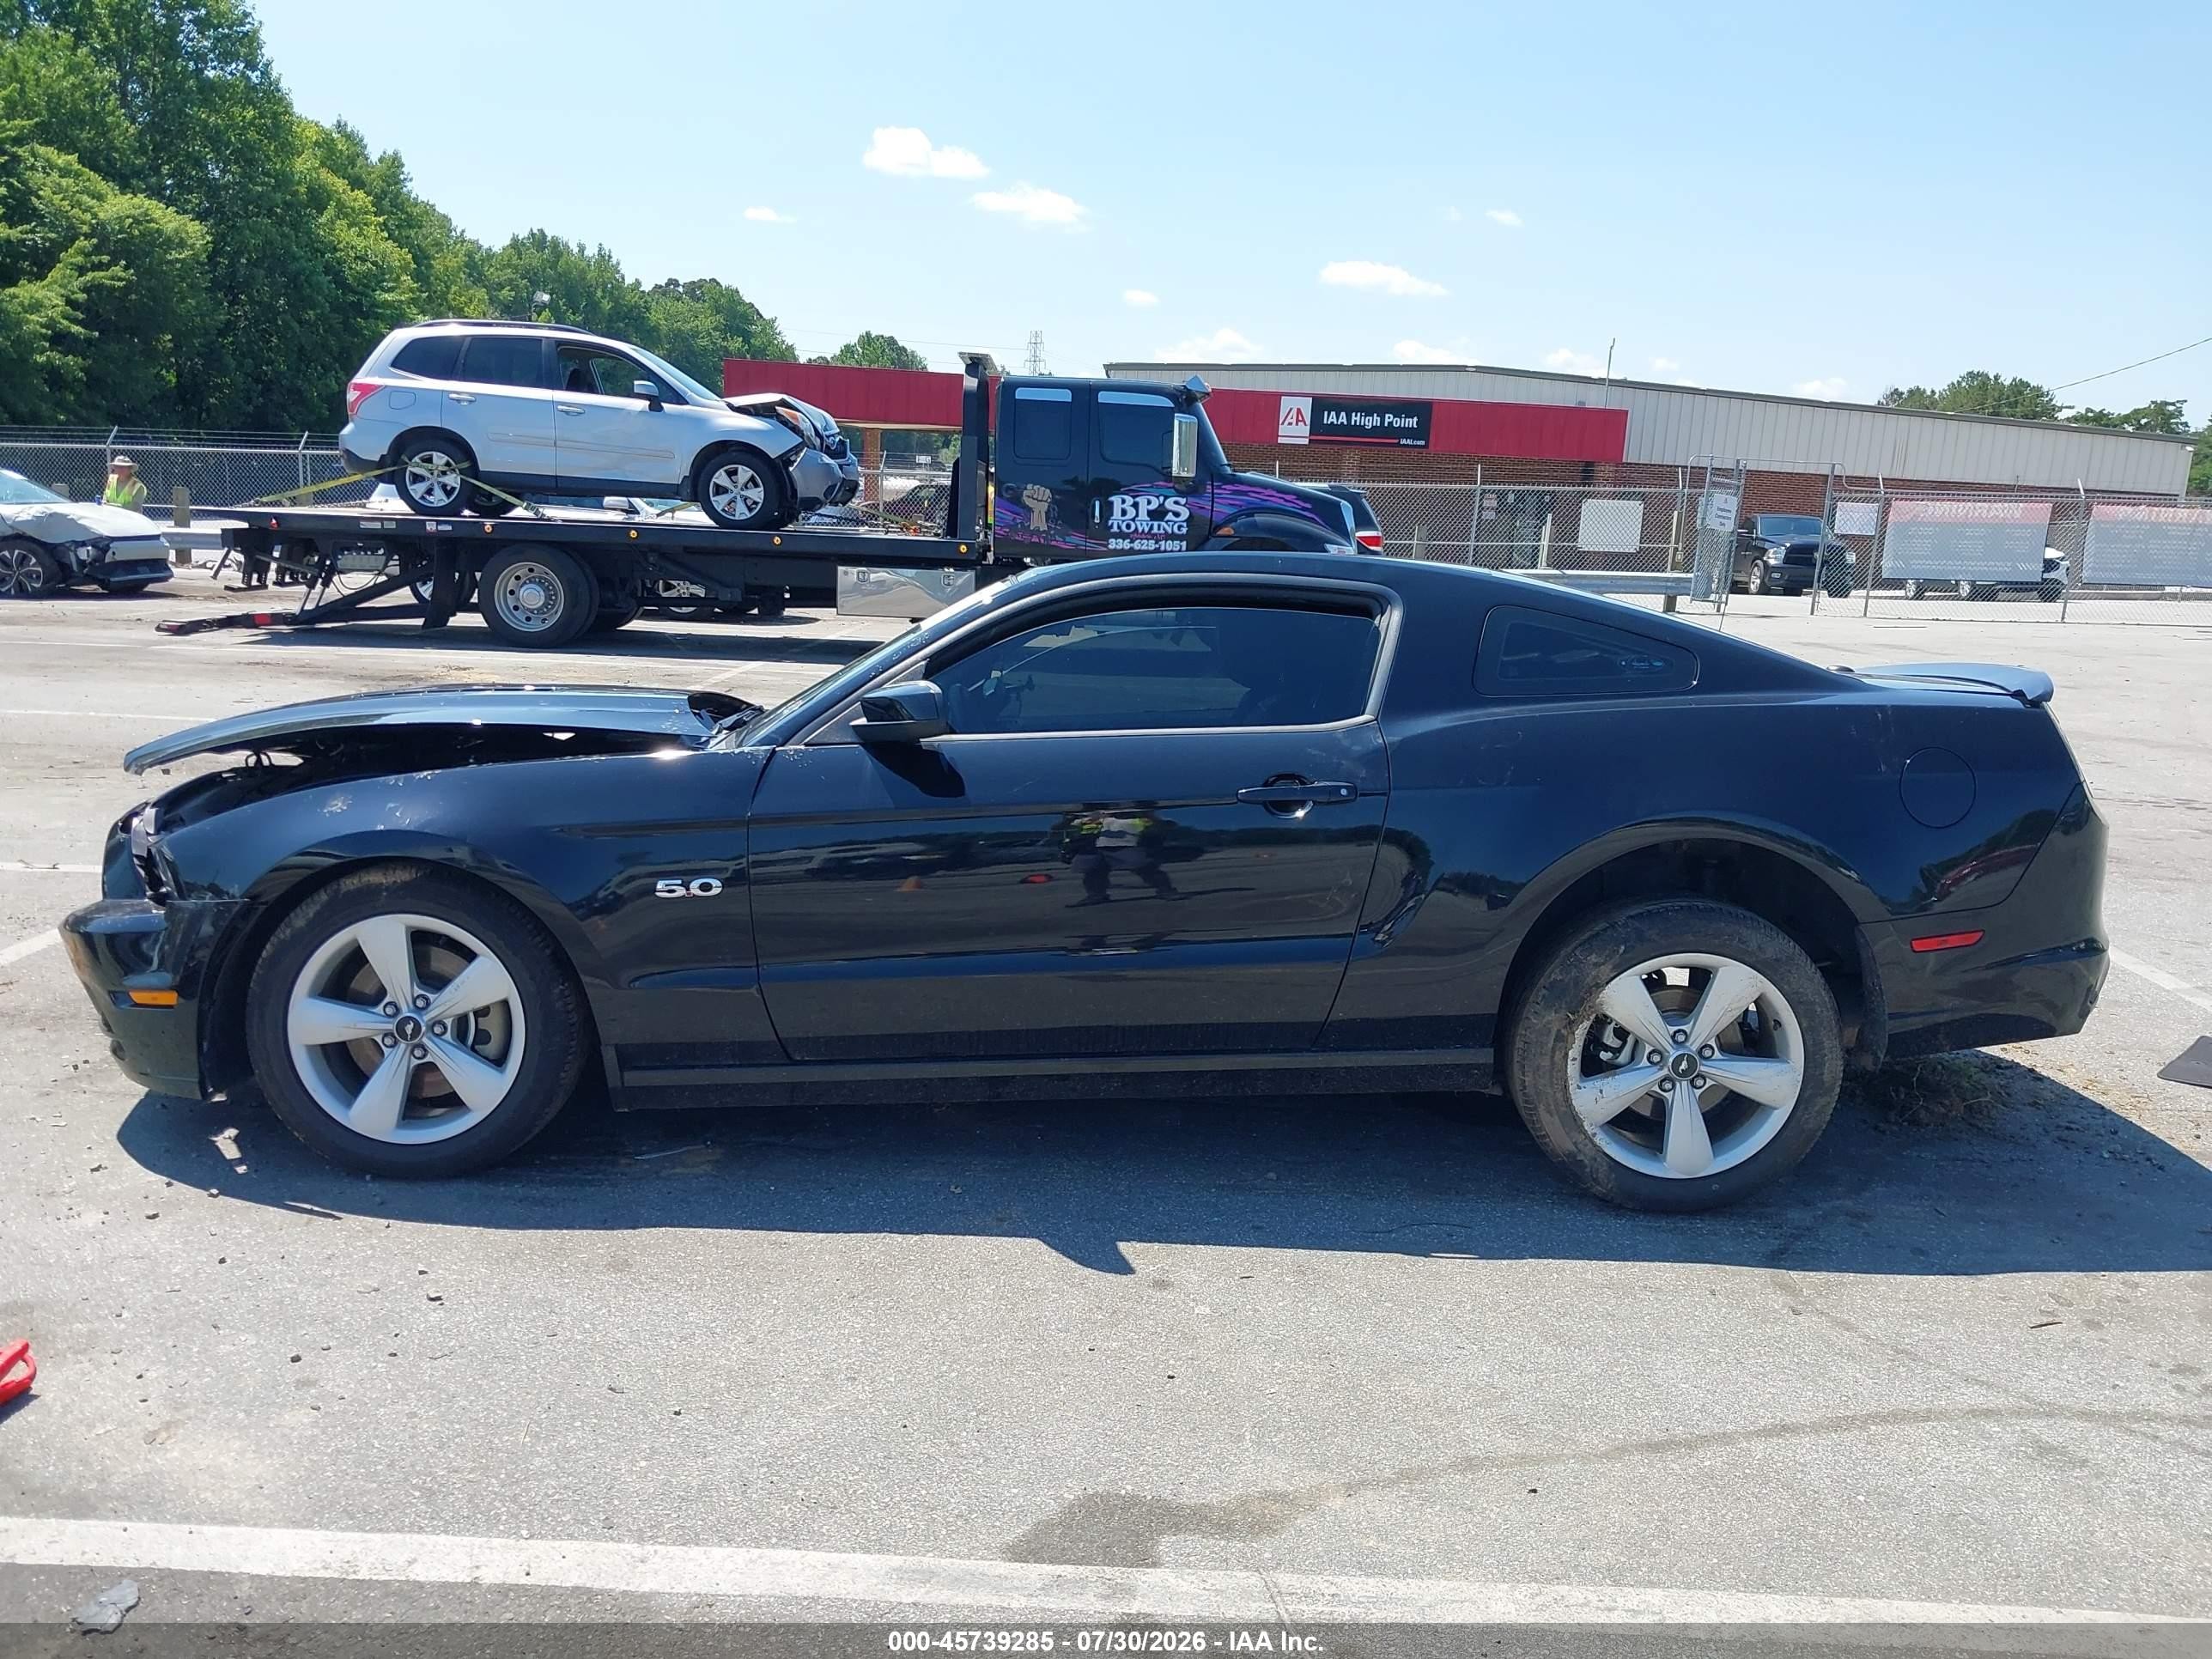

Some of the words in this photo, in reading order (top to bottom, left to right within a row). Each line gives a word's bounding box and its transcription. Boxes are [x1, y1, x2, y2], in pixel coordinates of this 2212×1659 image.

[1323, 410, 1347, 425] IAA
[1351, 411, 1381, 429] High
[1384, 413, 1419, 428] Point
[1108, 495, 1190, 522] BP'S
[1108, 520, 1188, 535] TOWING
[1107, 538, 1188, 551] 336-625-1051
[654, 878, 723, 898] 5.0
